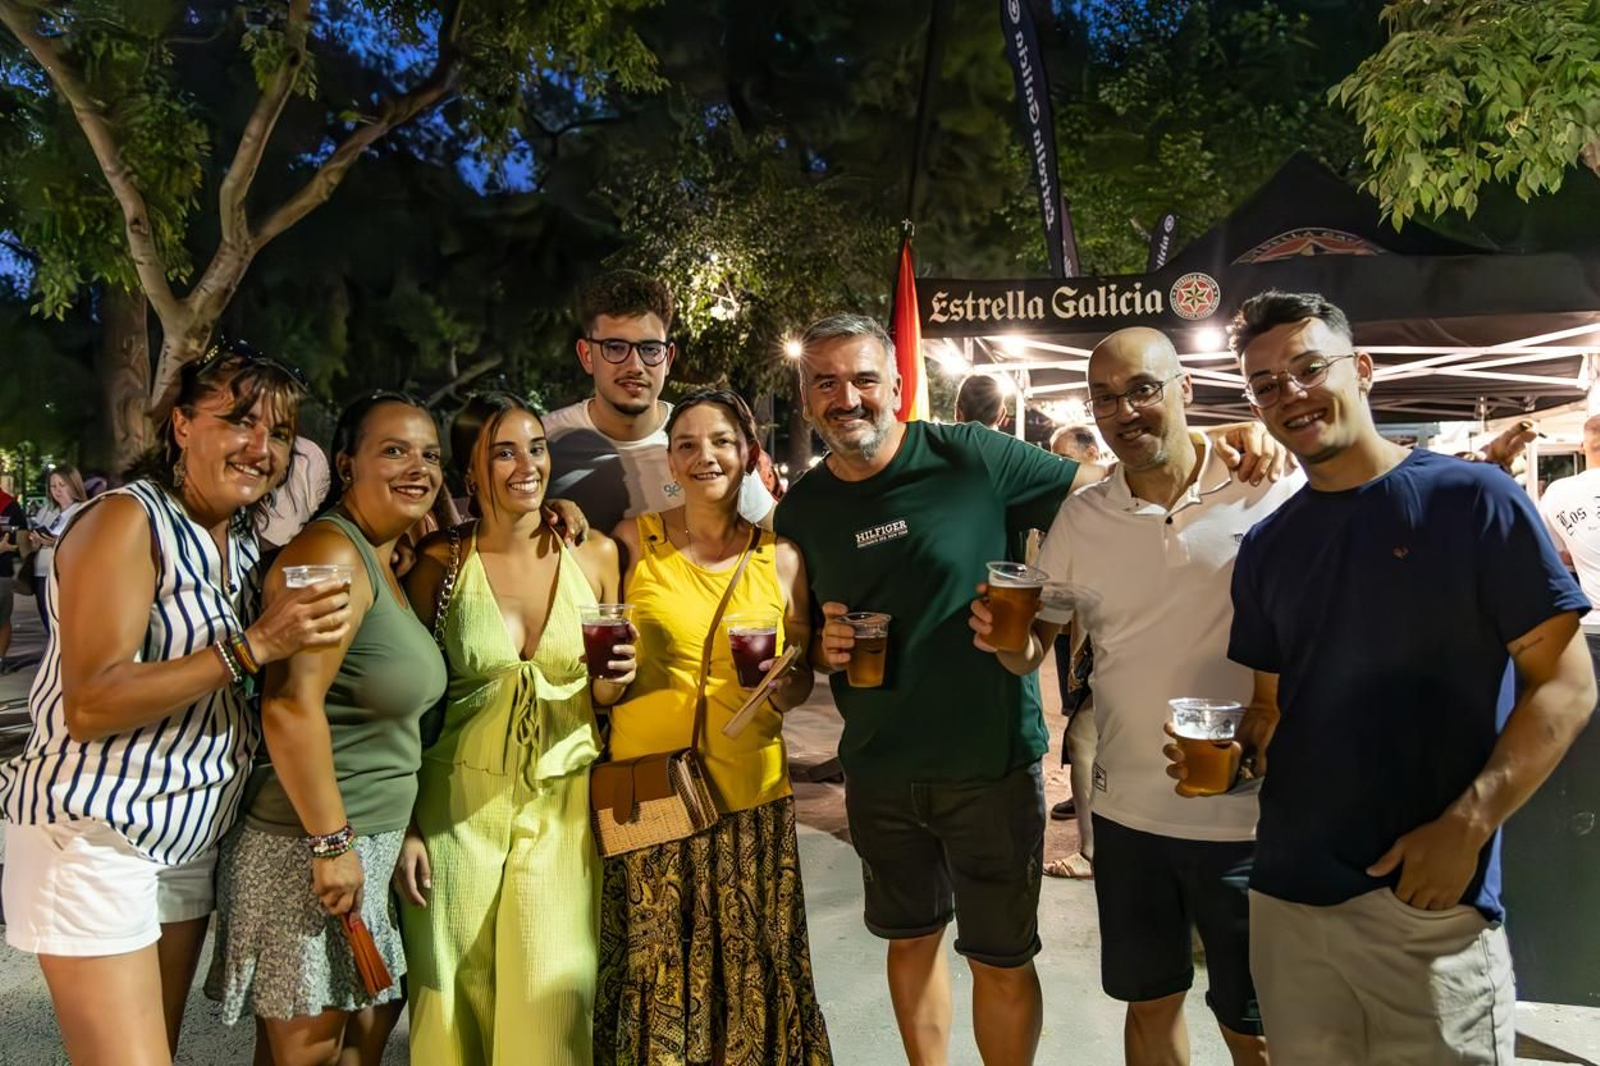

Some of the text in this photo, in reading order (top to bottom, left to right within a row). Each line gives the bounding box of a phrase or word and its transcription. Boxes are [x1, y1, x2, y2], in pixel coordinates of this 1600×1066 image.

[929, 290, 1045, 324] Estrella
[1052, 282, 1164, 319] Galicia
[855, 520, 907, 542] HILFIGER
[1556, 507, 1587, 537] Los
